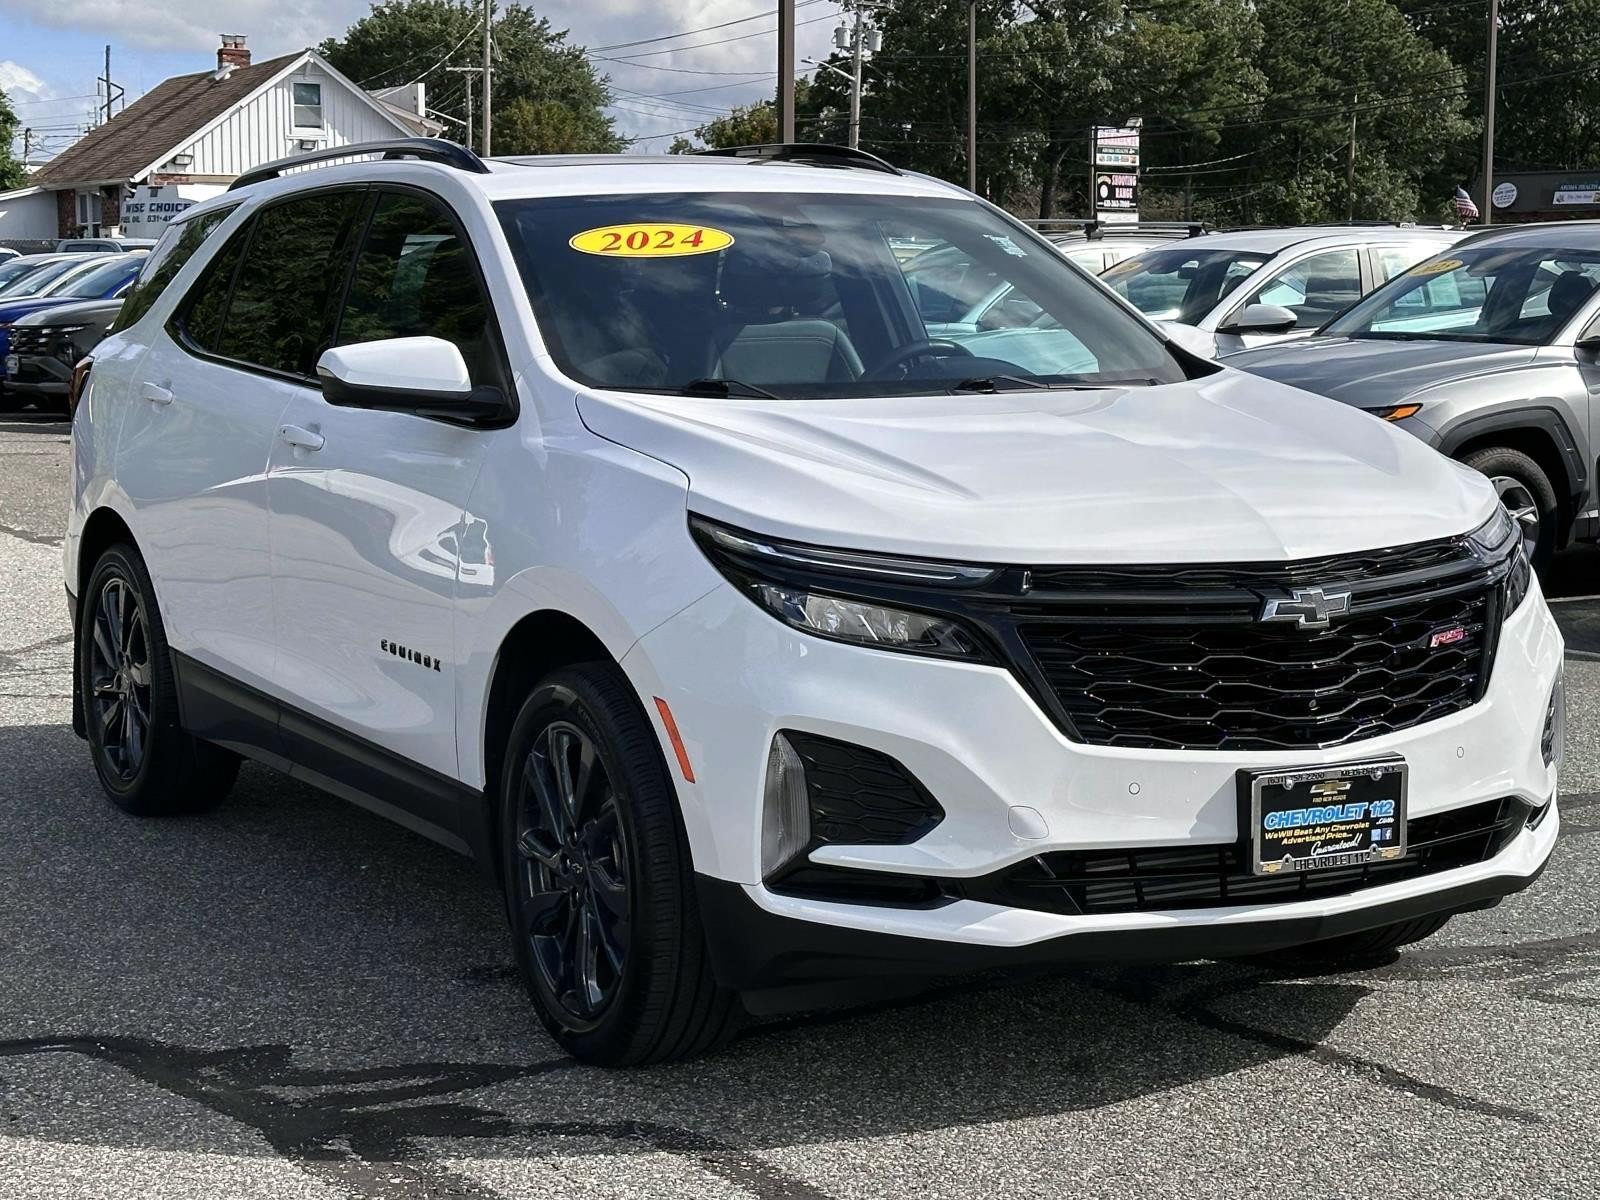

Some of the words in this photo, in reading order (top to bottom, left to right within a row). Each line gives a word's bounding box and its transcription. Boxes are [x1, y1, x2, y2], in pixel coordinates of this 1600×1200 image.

[1111, 175, 1137, 187] SHOOTING
[1115, 187, 1133, 199] RANGE
[125, 204, 145, 213] WISE
[600, 229, 704, 251] 2024
[381, 639, 441, 672] EQUINOX
[1264, 802, 1369, 830] CHEVROLET
[1369, 800, 1395, 818] 112
[1293, 828, 1313, 836] Beat
[1314, 826, 1331, 834] Any
[1331, 822, 1370, 832] Chevrolet
[1281, 833, 1326, 845] Advertised
[1294, 854, 1351, 871] CHEVROLET
[1353, 852, 1370, 863] 112
